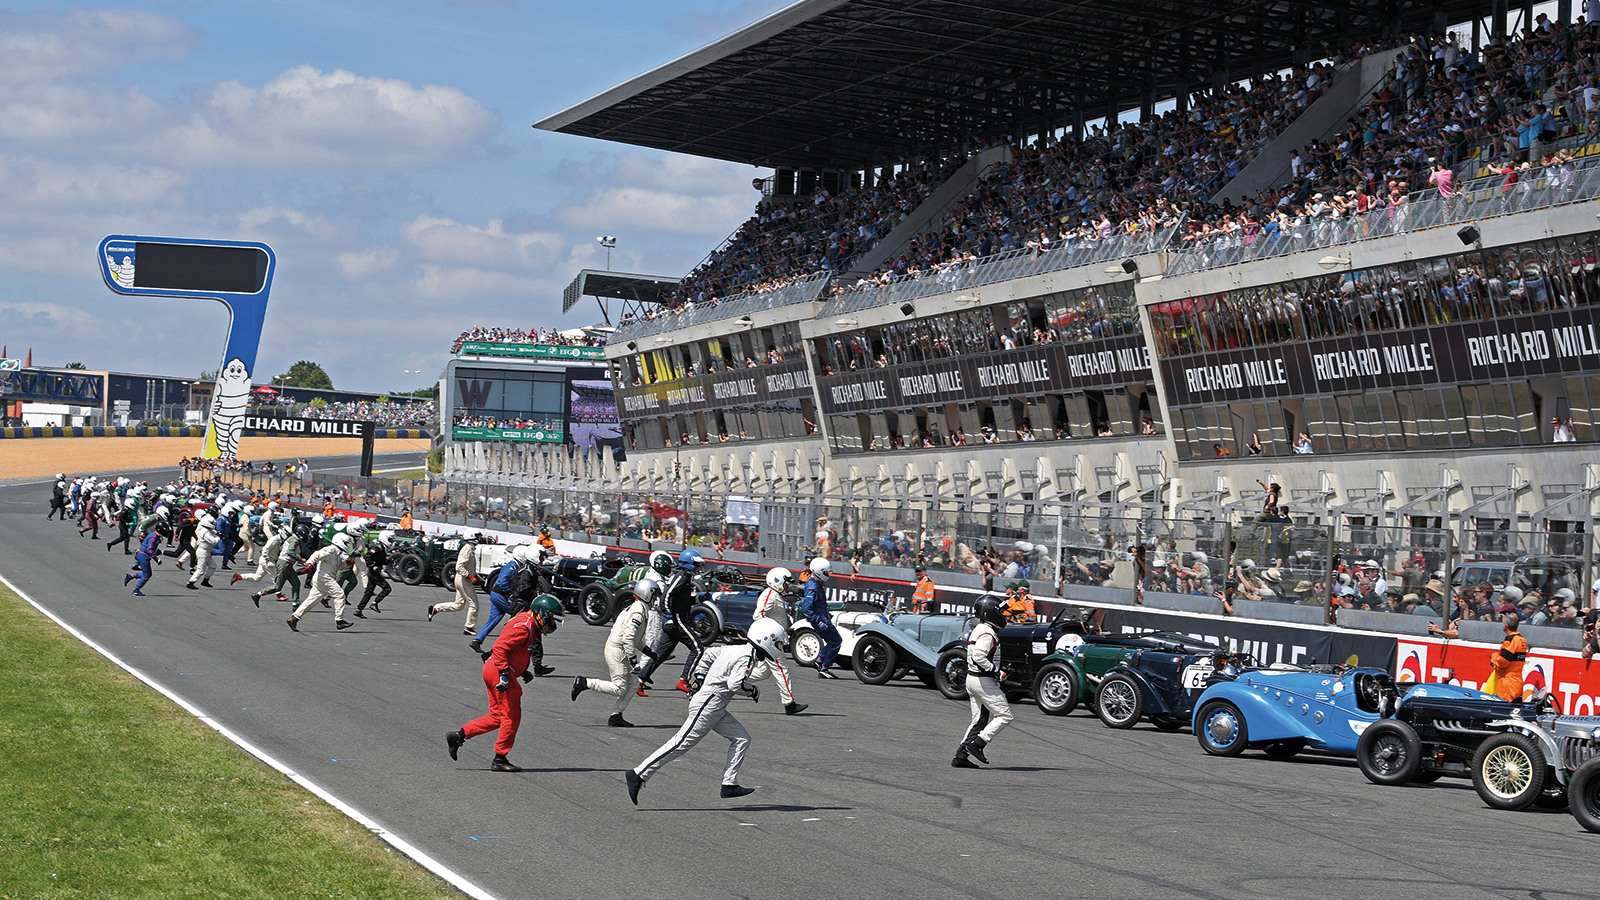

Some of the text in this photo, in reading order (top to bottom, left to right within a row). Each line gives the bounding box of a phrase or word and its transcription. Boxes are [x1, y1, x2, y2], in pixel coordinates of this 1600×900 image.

[1467, 324, 1600, 366] RICHARD MILL
[977, 359, 1050, 388] RICHARD MILLE
[1068, 346, 1152, 378] RICHARD MILLE
[1313, 343, 1434, 381] RICHARD MILLE
[766, 373, 795, 393] RICHARD
[900, 371, 963, 397] RICHARD MILLE
[1185, 358, 1287, 393] RICHARD MILLE
[666, 386, 706, 406] RICHARD MILLE
[713, 378, 757, 400] RICHARD MILLE
[831, 380, 887, 405] RICHARD MILLE
[624, 393, 660, 411] RICHARD MILLE
[242, 417, 363, 436] ICHARD MILLE
[1192, 672, 1208, 687] 65
